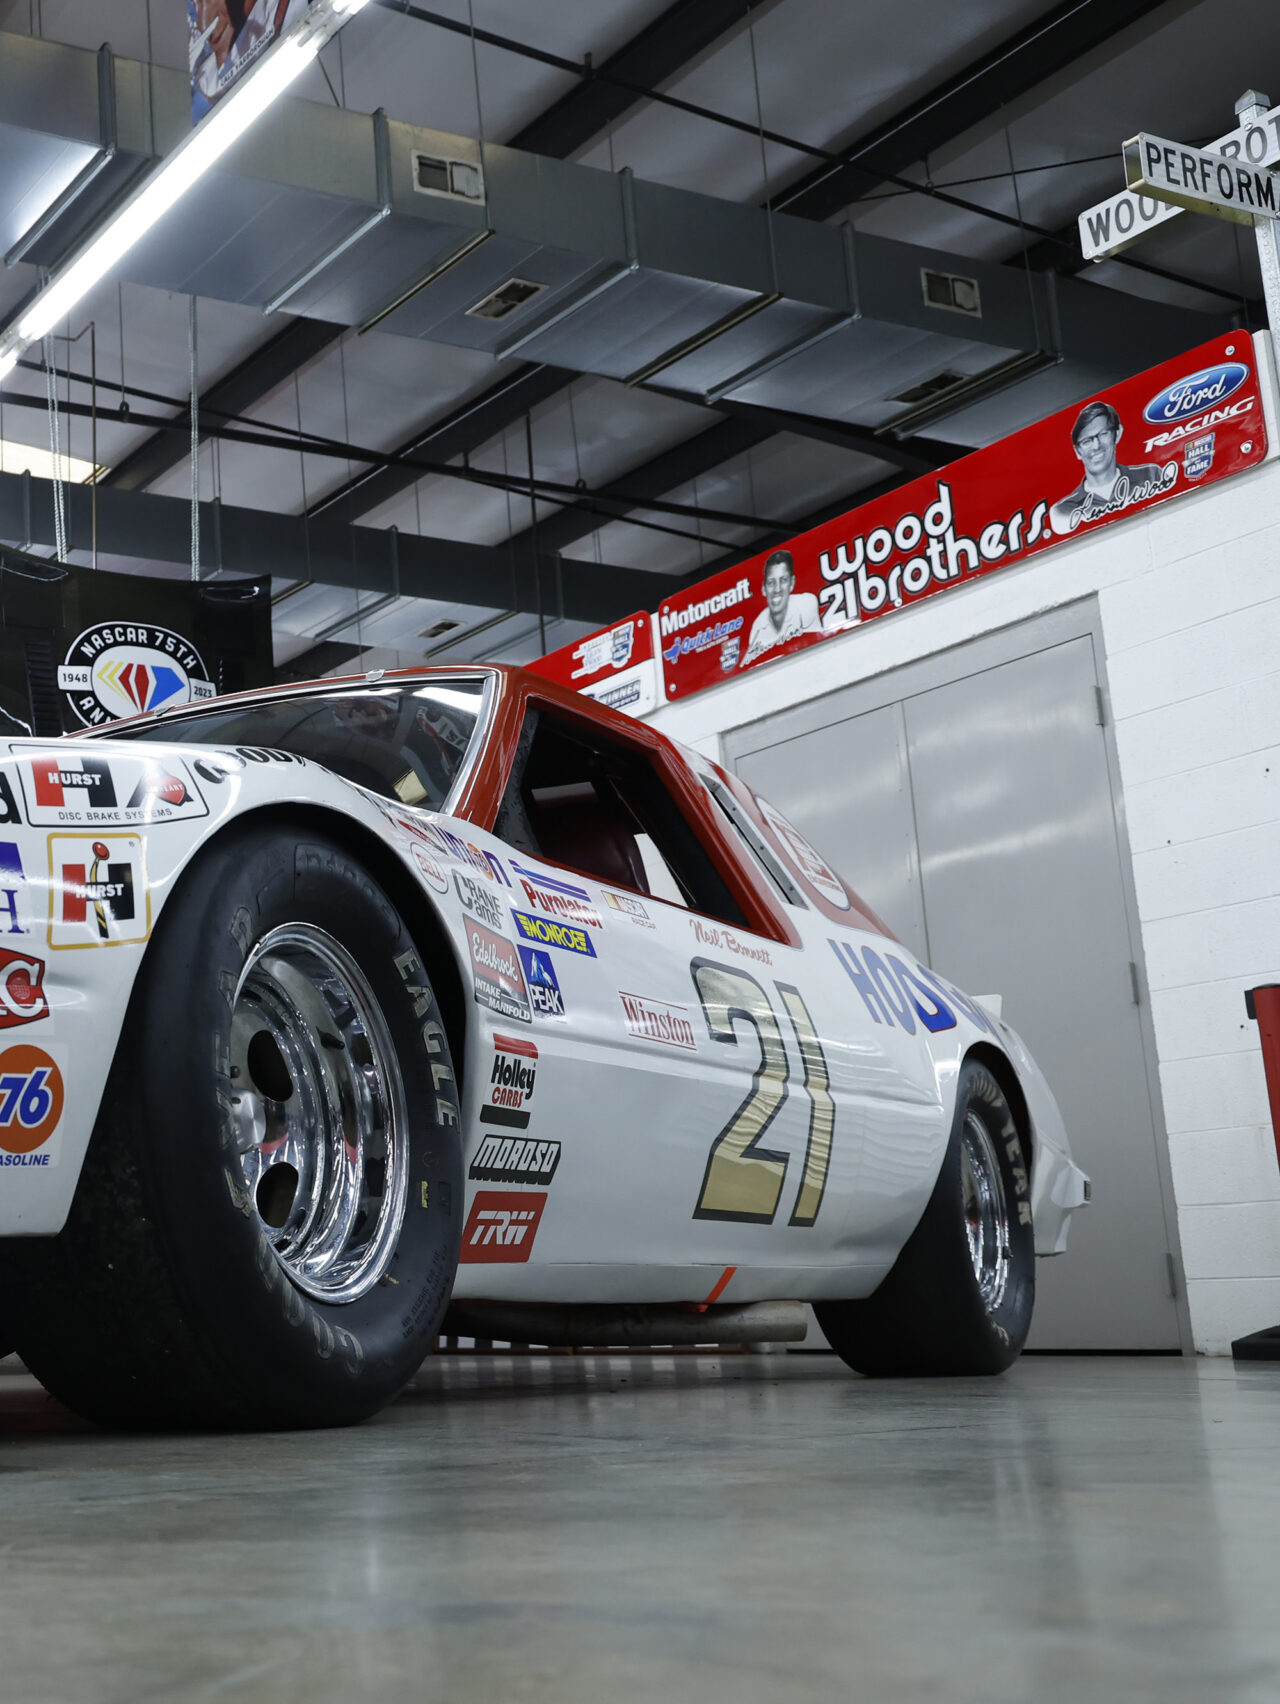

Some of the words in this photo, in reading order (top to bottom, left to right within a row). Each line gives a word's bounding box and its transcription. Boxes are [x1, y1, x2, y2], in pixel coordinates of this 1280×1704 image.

[1145, 141, 1280, 212] PERFORM
[1086, 195, 1175, 248] WOO
[1164, 373, 1227, 418] Ford
[1143, 395, 1256, 454] RACING
[1187, 459, 1209, 475] FAME
[1188, 444, 1209, 459] HALL
[819, 479, 954, 583] wood
[661, 577, 753, 637] Motorcraft
[80, 625, 148, 659] NASCAR
[154, 630, 197, 671] 75TH
[681, 626, 715, 655] Quick
[713, 615, 744, 641] Lane
[62, 672, 88, 685] 1948
[193, 685, 213, 699] 2023
[48, 771, 102, 787] HURST
[58, 811, 82, 821] DISC
[87, 812, 120, 821] BRAKE
[75, 883, 125, 899] HURST
[519, 878, 604, 930] Purolator
[525, 916, 589, 953] MONROE
[689, 918, 723, 949] Neil
[472, 932, 518, 982] Edelbrock
[475, 978, 502, 999] INTAKE
[528, 983, 565, 1014] PEAK
[488, 996, 531, 1021] MANIFOLD
[620, 995, 697, 1047] Winston
[393, 947, 460, 1133] EAGLE
[490, 1054, 537, 1101] Holley
[689, 956, 838, 1228] 21
[491, 1086, 523, 1109] CARBS
[471, 1136, 561, 1173] MOROSO
[469, 1210, 536, 1245] TRW
